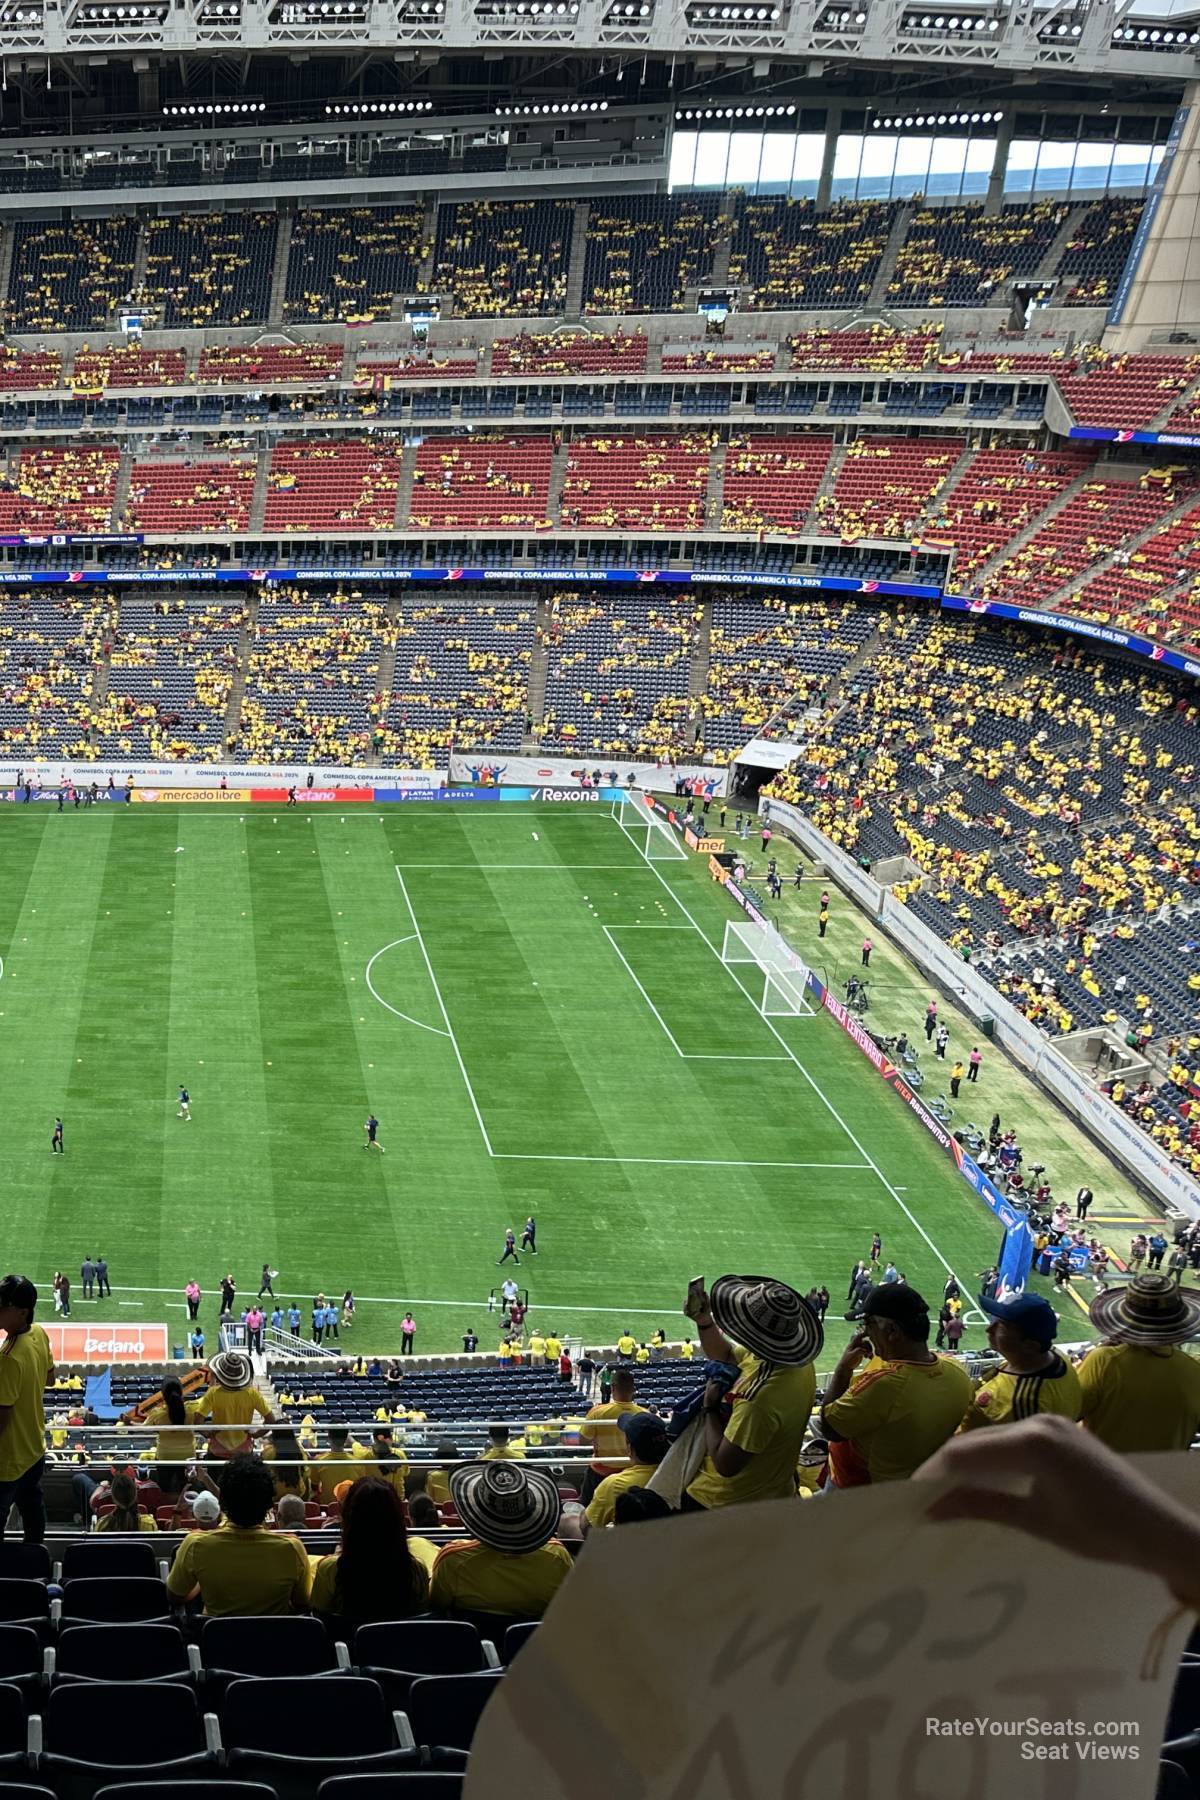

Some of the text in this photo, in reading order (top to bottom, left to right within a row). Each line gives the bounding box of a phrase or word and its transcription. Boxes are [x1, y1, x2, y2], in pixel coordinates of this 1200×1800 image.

[691, 574, 732, 582] CONMEBOL
[752, 576, 786, 584] AMERICA
[163, 791, 241, 800] mercado libre
[542, 788, 599, 801] Rexona
[698, 842, 724, 850] mer
[847, 1018, 882, 1068] CENTENARIO
[894, 1079, 912, 1102] INTER
[84, 1339, 144, 1353] Betano
